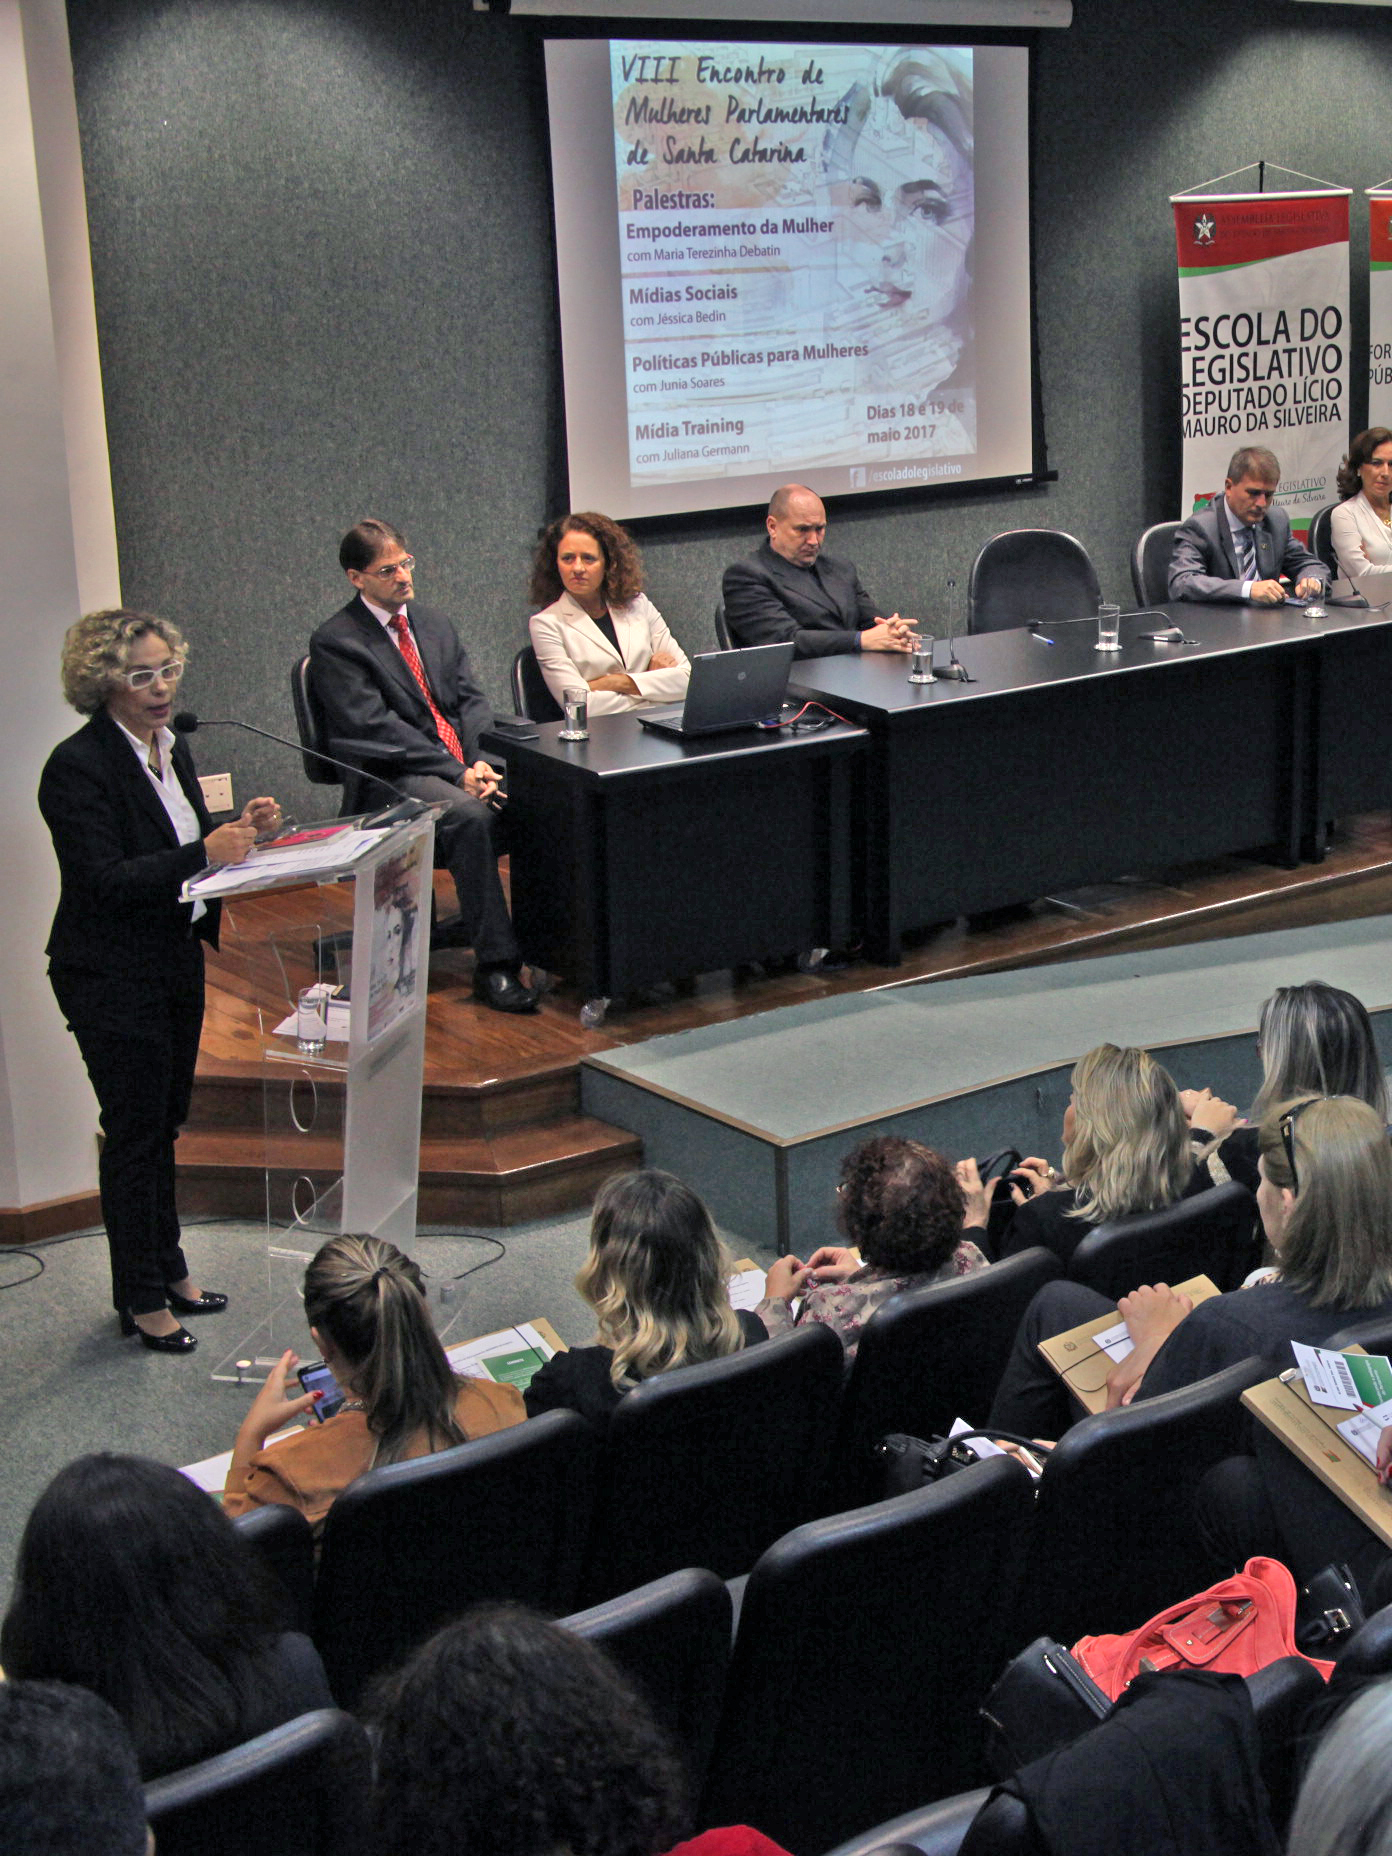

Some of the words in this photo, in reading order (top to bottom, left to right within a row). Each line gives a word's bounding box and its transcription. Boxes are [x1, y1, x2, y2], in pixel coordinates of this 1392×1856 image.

[621, 53, 682, 85] VIII
[696, 56, 786, 85] Encontro
[801, 59, 824, 85] de
[625, 95, 712, 126] Mulheres
[725, 94, 850, 125] Parlamentares
[627, 138, 649, 165] de
[663, 135, 717, 164] Santa
[729, 135, 808, 165] Catarina
[633, 188, 715, 210] Palestras:
[626, 221, 757, 243] Empoderamento
[760, 218, 779, 235] da
[782, 217, 834, 234] Mulher
[627, 251, 652, 262] com
[654, 248, 685, 261] Maria
[686, 245, 737, 260] Terezinha
[739, 243, 781, 258] Debatin
[629, 286, 682, 305] Mídias
[685, 283, 738, 302] Sociais
[630, 315, 655, 327] com
[656, 312, 693, 326] Jéssica
[695, 309, 727, 324] Bedin
[1180, 310, 1291, 352] ESCOLA
[1300, 305, 1342, 342] DO
[632, 353, 698, 372] Políticas
[701, 349, 764, 368] Públicas
[767, 348, 800, 367] para
[803, 343, 869, 361] Mulheres
[633, 381, 658, 394] com
[659, 378, 688, 393] Junia
[690, 376, 726, 389] Soares
[1182, 383, 1287, 417] DEPUTADO
[1293, 376, 1342, 405] LÍCIO
[867, 405, 897, 420] Dias
[899, 403, 916, 418] 18
[918, 404, 927, 416] e
[929, 401, 946, 415] 19
[949, 399, 965, 414] de
[1183, 414, 1242, 439] MAURO
[1246, 411, 1269, 432] DA
[1273, 402, 1342, 429] SILVEIRA
[635, 422, 680, 441] Mídia
[682, 417, 745, 436] Training
[867, 428, 901, 444] maio
[904, 424, 937, 441] 2017
[636, 452, 660, 465] com
[662, 447, 700, 462] Juliana
[702, 443, 750, 458] Germann
[868, 463, 962, 484] /escoladolegislativo
[1277, 476, 1327, 493] EGISLATIVO
